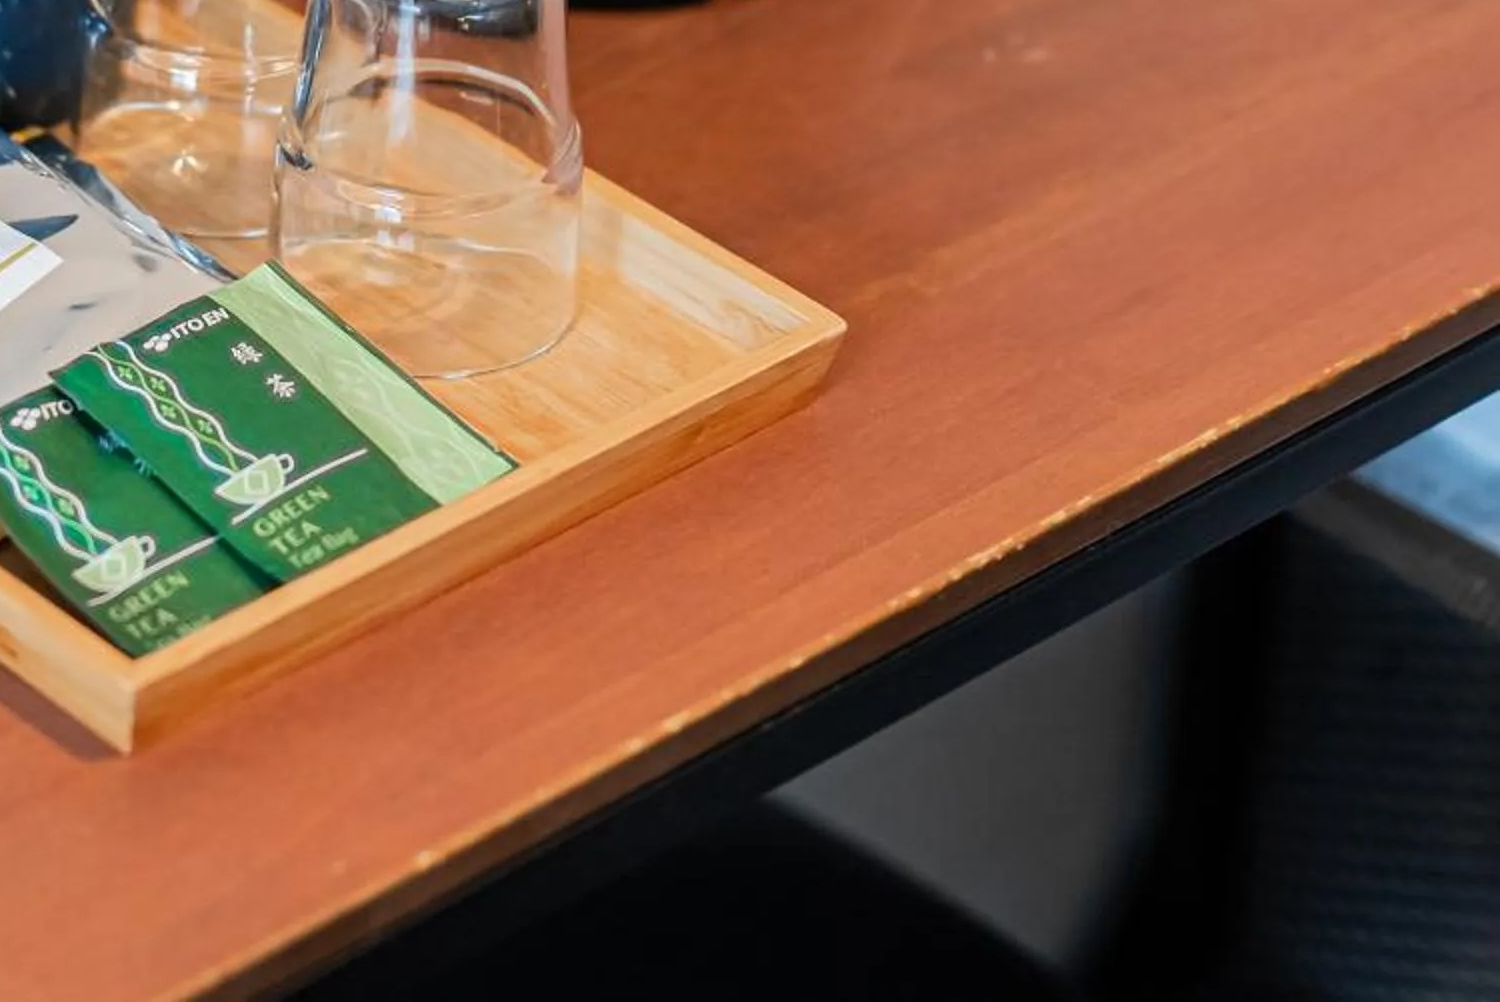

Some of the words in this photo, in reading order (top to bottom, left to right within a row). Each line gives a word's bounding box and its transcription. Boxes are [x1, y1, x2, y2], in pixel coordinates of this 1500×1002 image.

[253, 484, 331, 537] GREEN
[269, 520, 322, 555] TEA
[108, 569, 189, 622] GREEN
[123, 607, 178, 638] TEA
